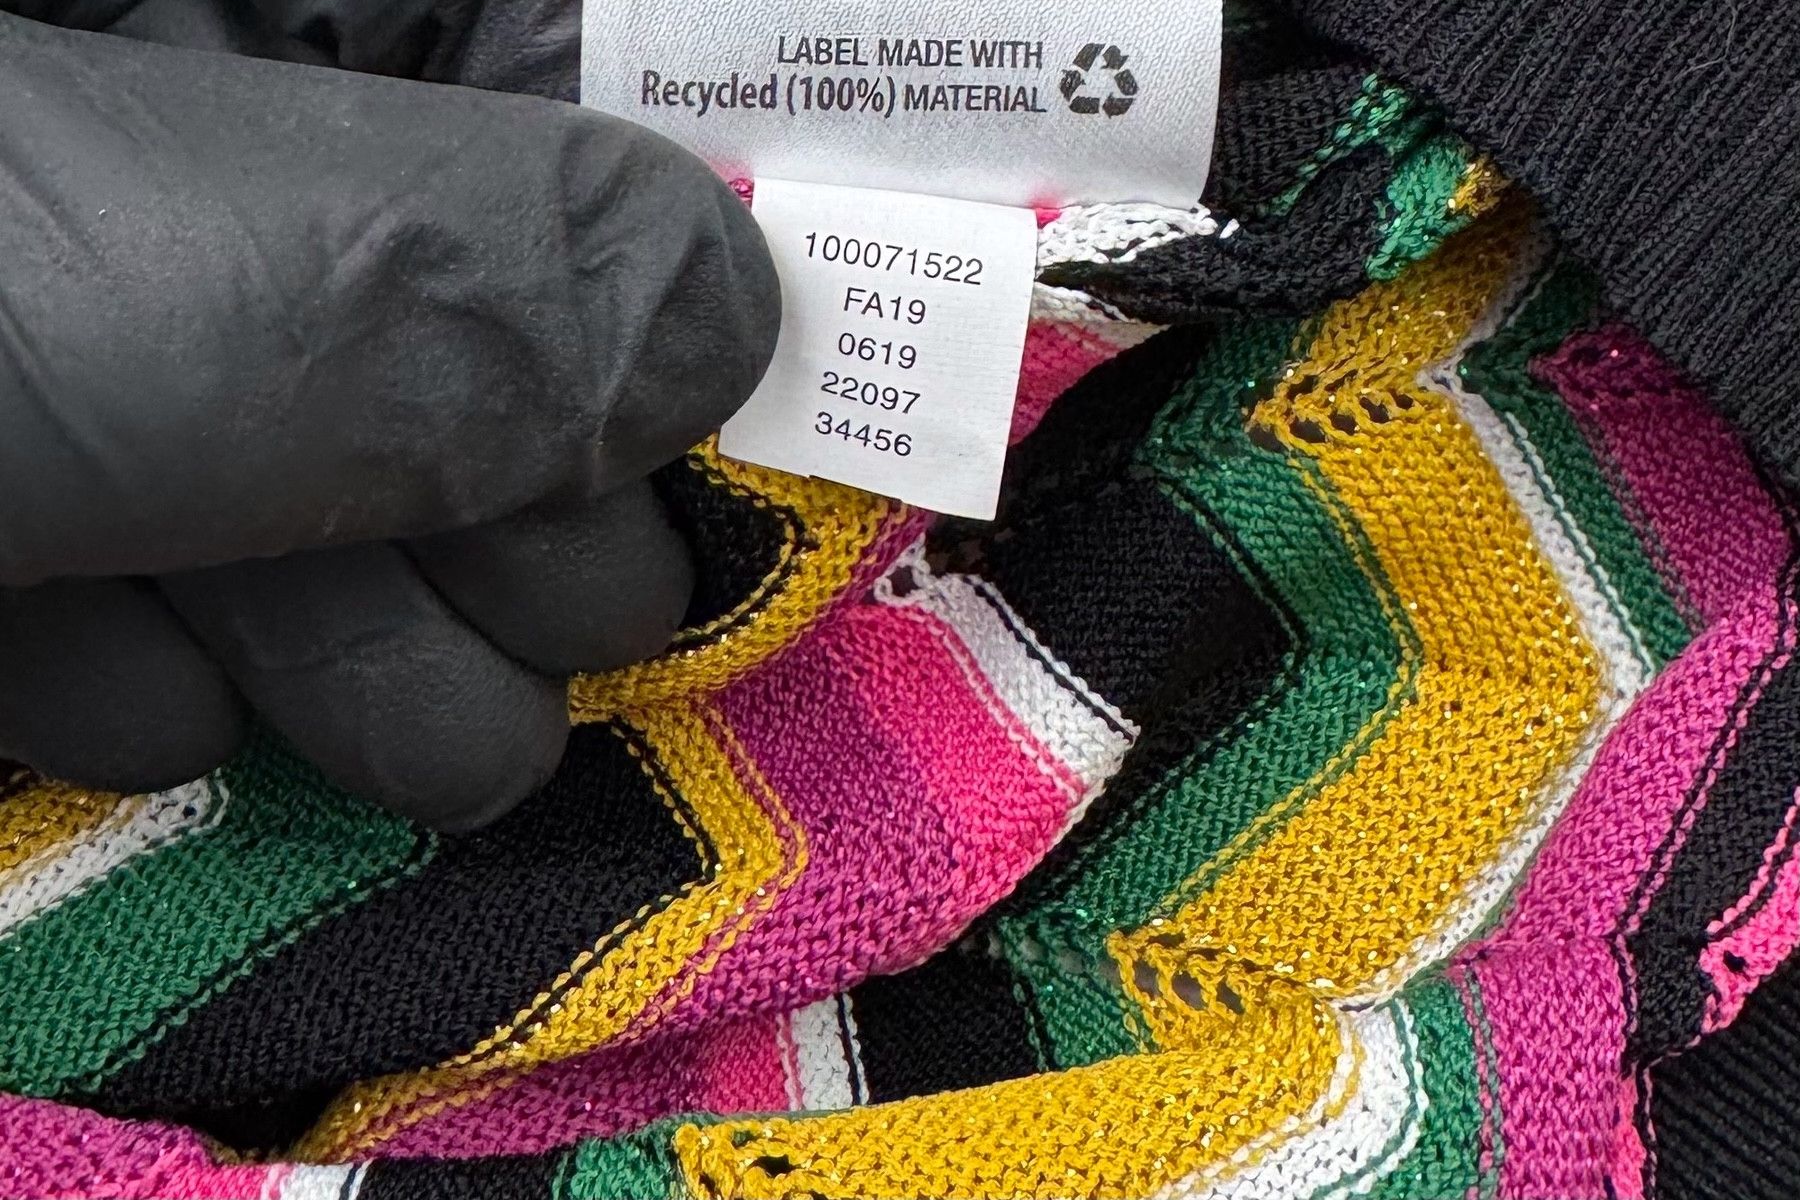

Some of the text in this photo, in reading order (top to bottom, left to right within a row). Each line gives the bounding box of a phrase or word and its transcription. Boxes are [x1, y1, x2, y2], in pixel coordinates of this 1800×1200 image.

[777, 35, 1043, 69] LABEL MADE WITH
[641, 69, 1047, 119] Recycled (100%) MATERIAL
[805, 231, 983, 285] 100071522
[843, 287, 926, 325] FA19
[837, 332, 917, 369] 0619
[820, 371, 921, 414] 22097
[814, 411, 912, 457] 34456
